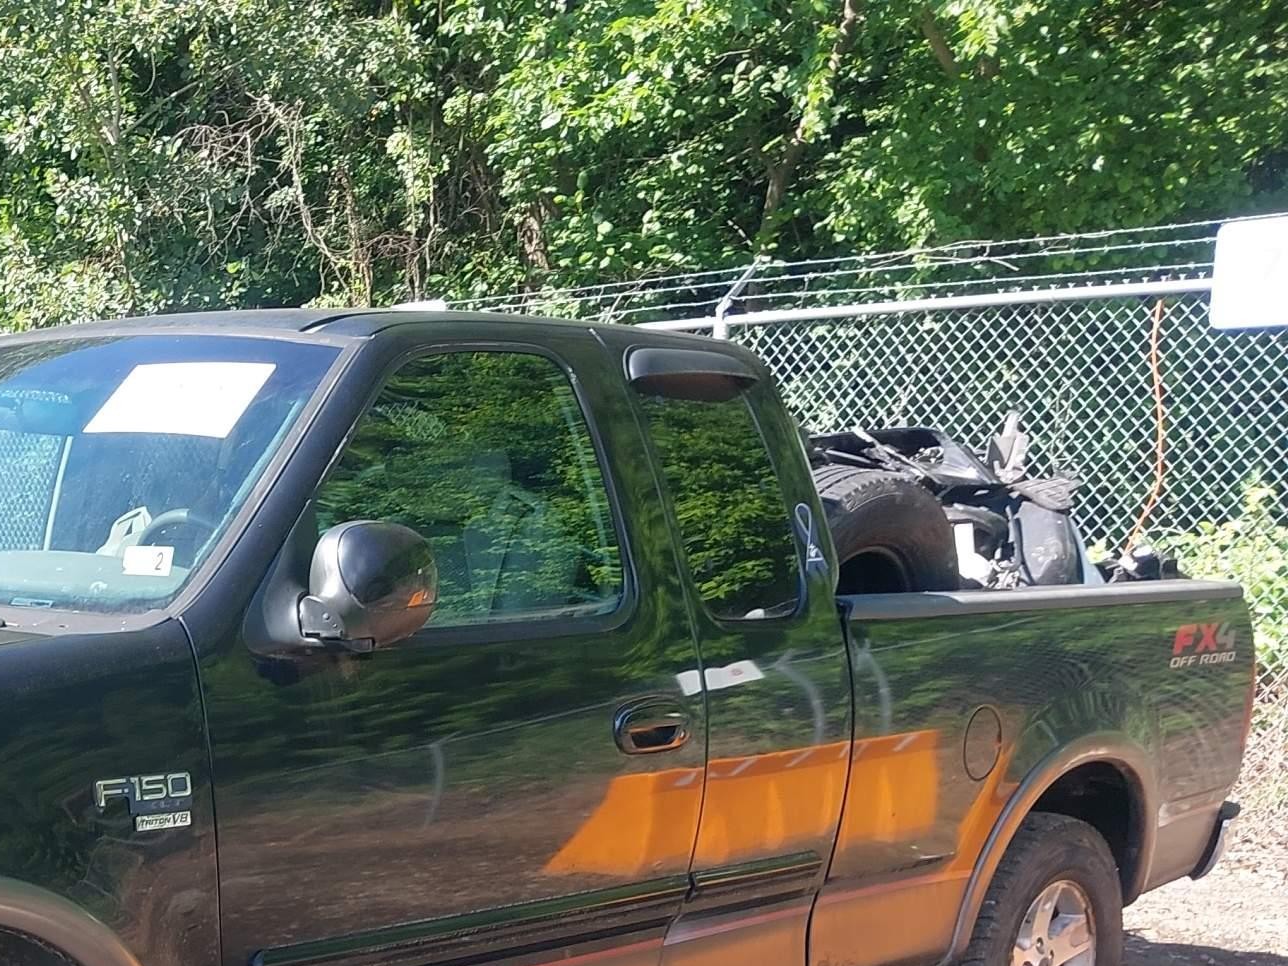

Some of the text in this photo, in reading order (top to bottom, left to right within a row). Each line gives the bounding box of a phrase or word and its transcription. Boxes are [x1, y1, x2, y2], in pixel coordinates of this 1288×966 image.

[1172, 621, 1237, 655] FX4
[1169, 651, 1236, 668] OFF ROAD
